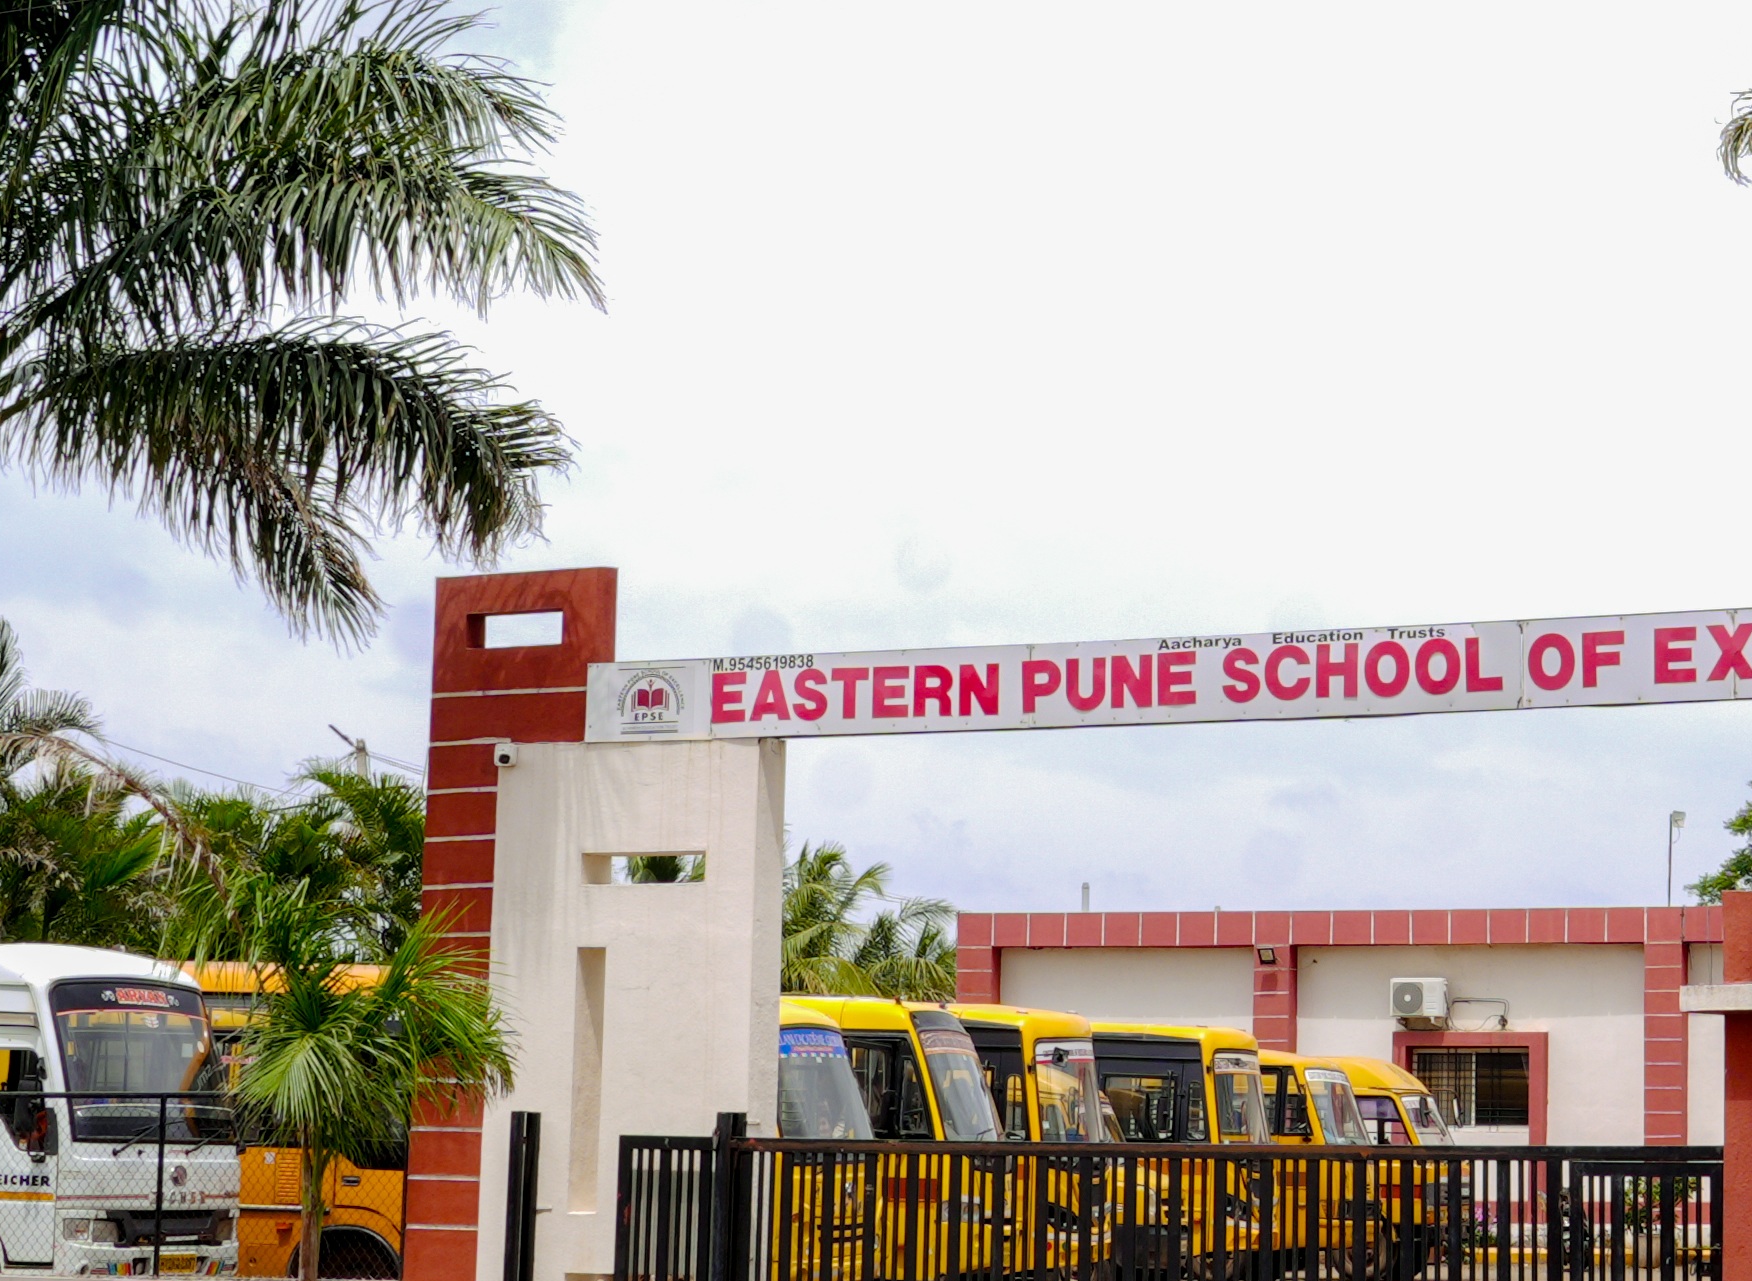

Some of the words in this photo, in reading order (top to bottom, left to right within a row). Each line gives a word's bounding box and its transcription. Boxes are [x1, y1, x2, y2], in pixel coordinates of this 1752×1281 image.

[1158, 636, 1242, 651] Aacharya
[1272, 630, 1364, 645] Education
[1387, 626, 1445, 640] Trusts
[712, 655, 814, 672] M.9545619838
[711, 663, 1000, 724] EASTERN
[1021, 651, 1197, 714] PUNE
[1222, 637, 1504, 704] SCHOOL
[1527, 630, 1625, 691] OF
[634, 711, 664, 721] EPSE
